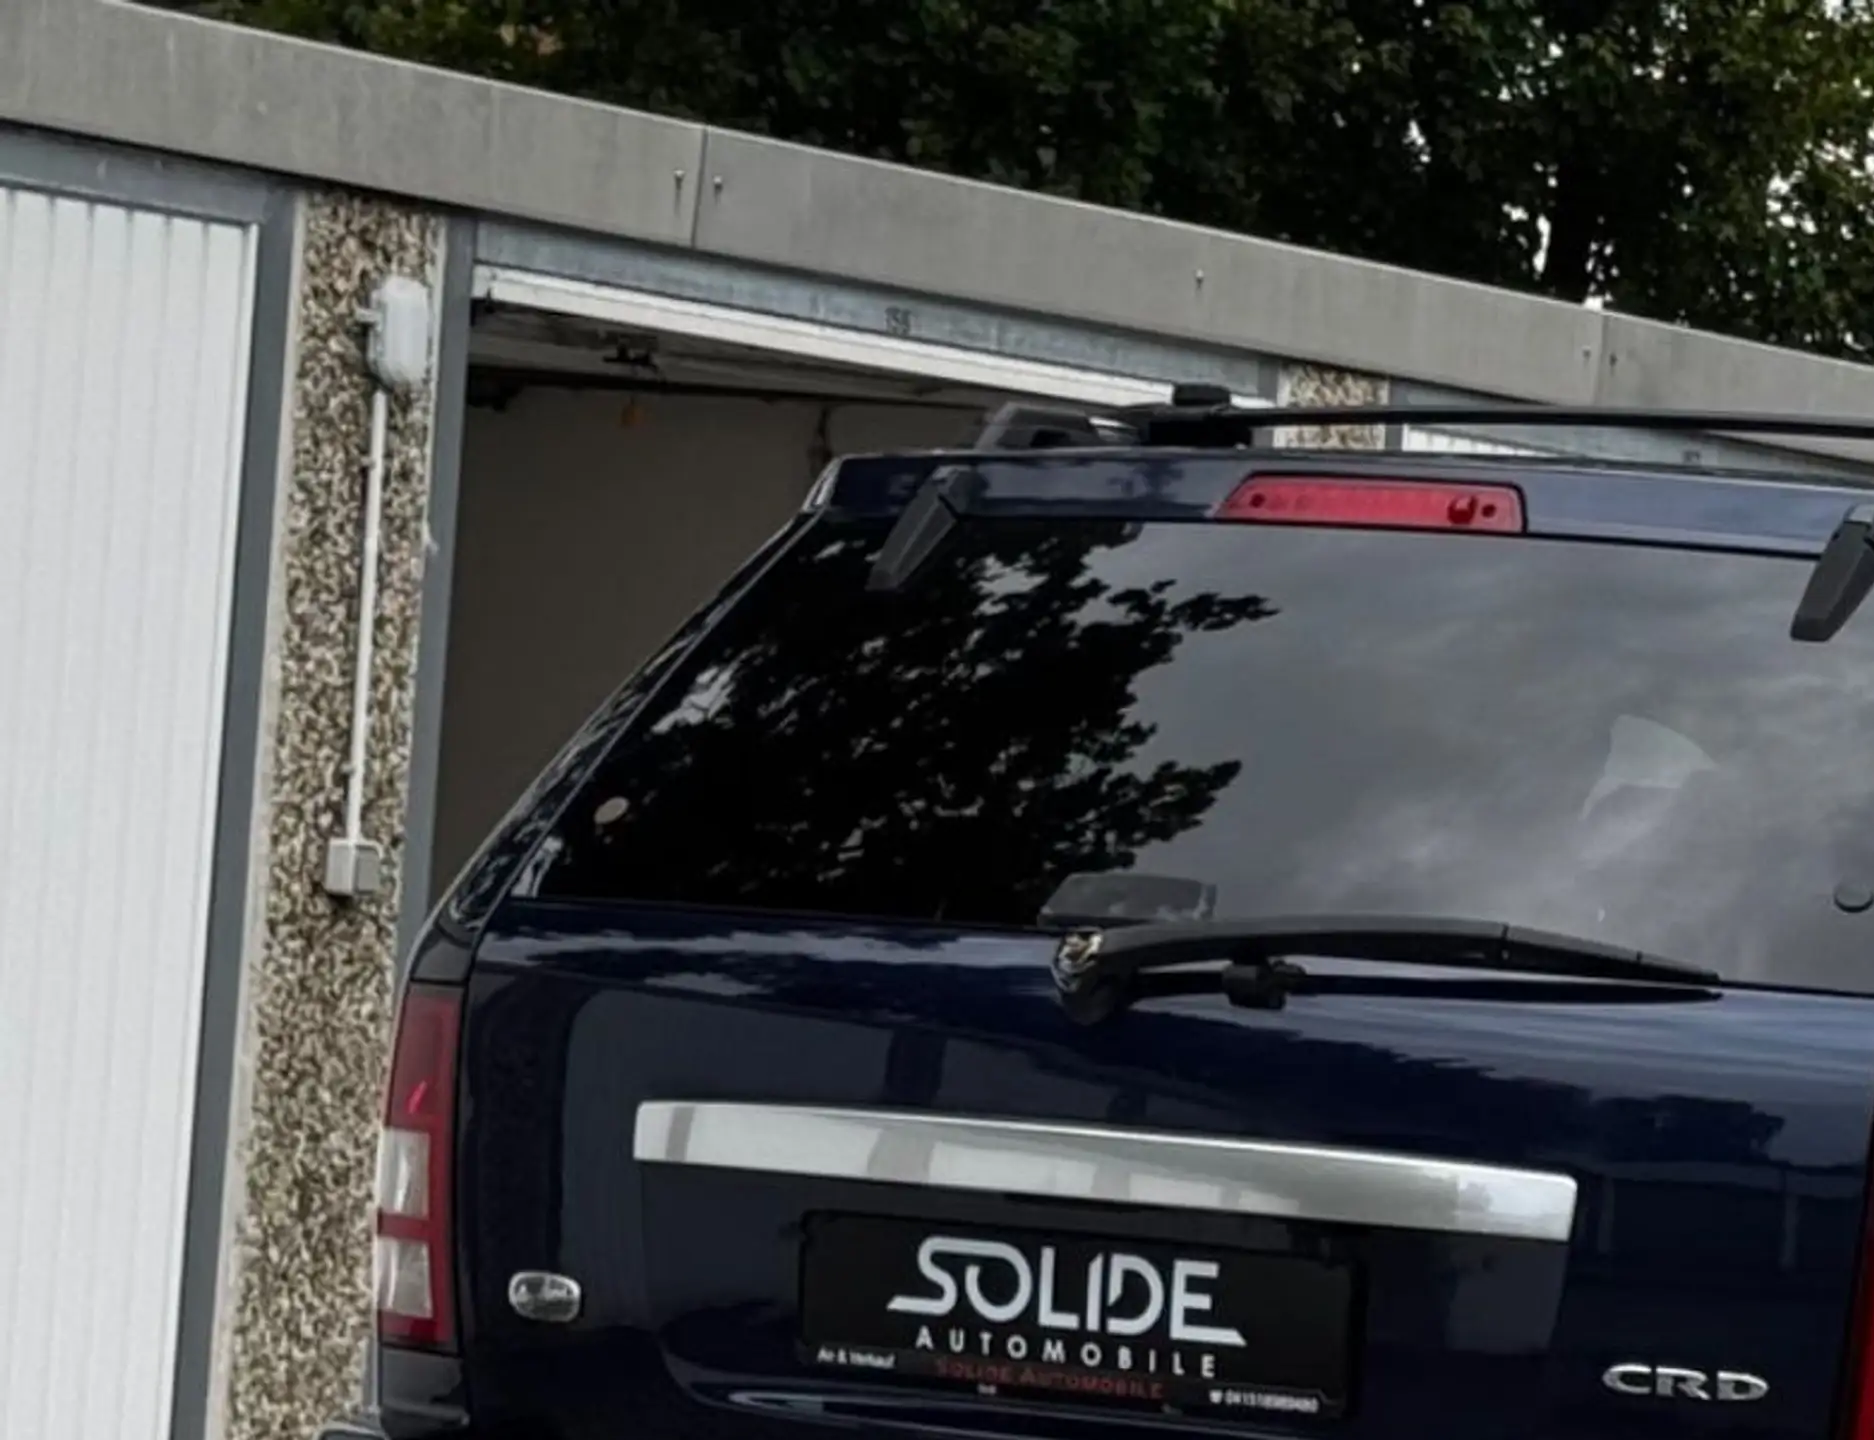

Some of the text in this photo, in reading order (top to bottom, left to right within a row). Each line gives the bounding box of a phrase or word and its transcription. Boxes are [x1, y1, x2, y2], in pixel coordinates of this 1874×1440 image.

[887, 1235, 1247, 1346] SOLIDE
[914, 1325, 1217, 1379] AUTOMOBILE
[1602, 1363, 1770, 1401] CRD
